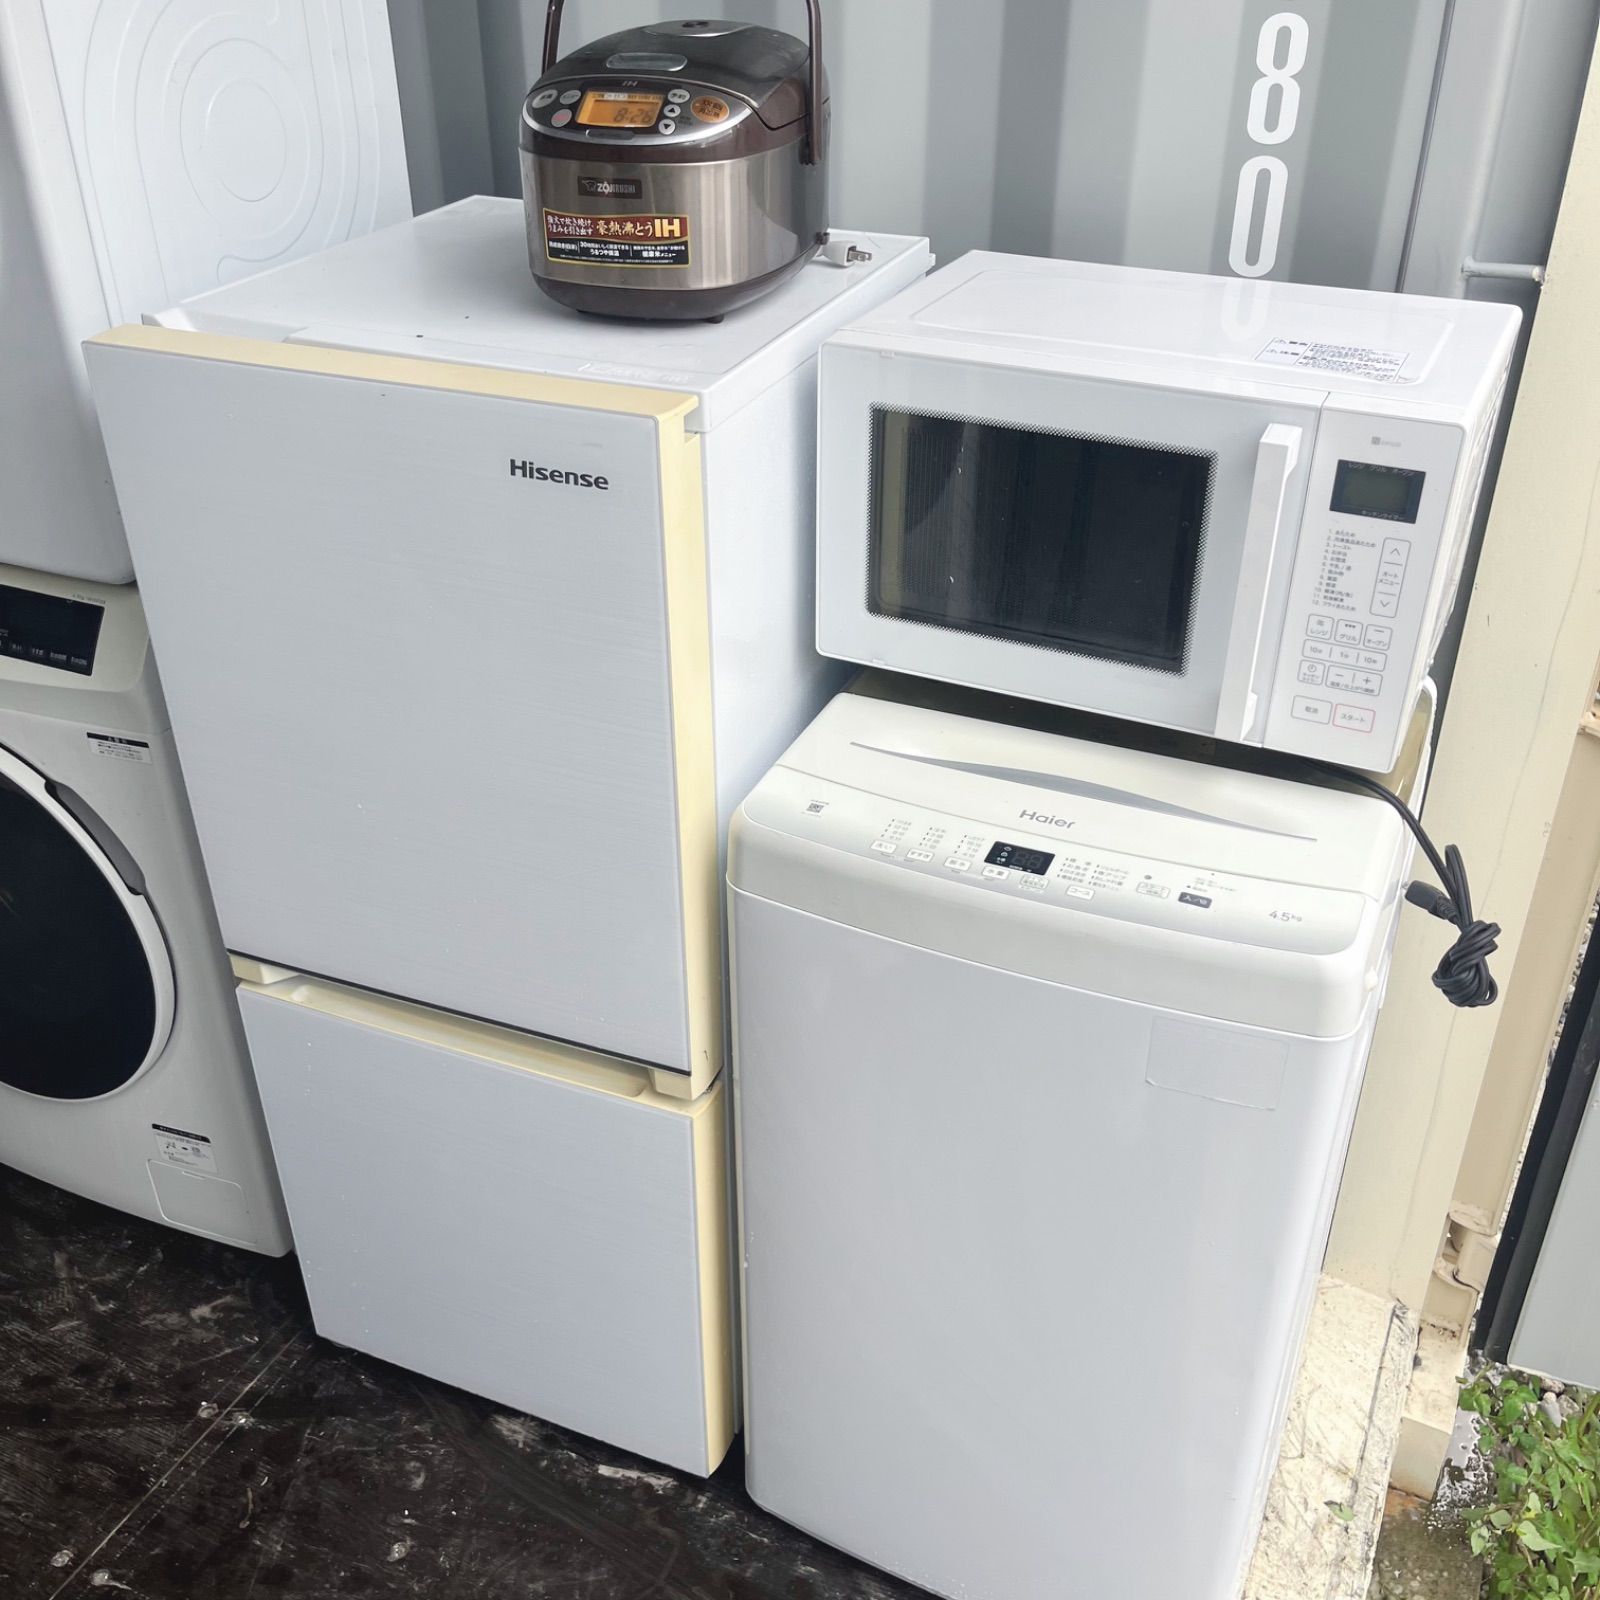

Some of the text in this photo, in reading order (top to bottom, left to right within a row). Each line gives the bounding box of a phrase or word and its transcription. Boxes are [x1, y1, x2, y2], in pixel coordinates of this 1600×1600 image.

[510, 459, 609, 490] Hisense
[1310, 628, 1328, 636] レンジ
[1340, 633, 1357, 642] グリル
[1341, 713, 1365, 723] スタート
[1019, 809, 1076, 829] Haier
